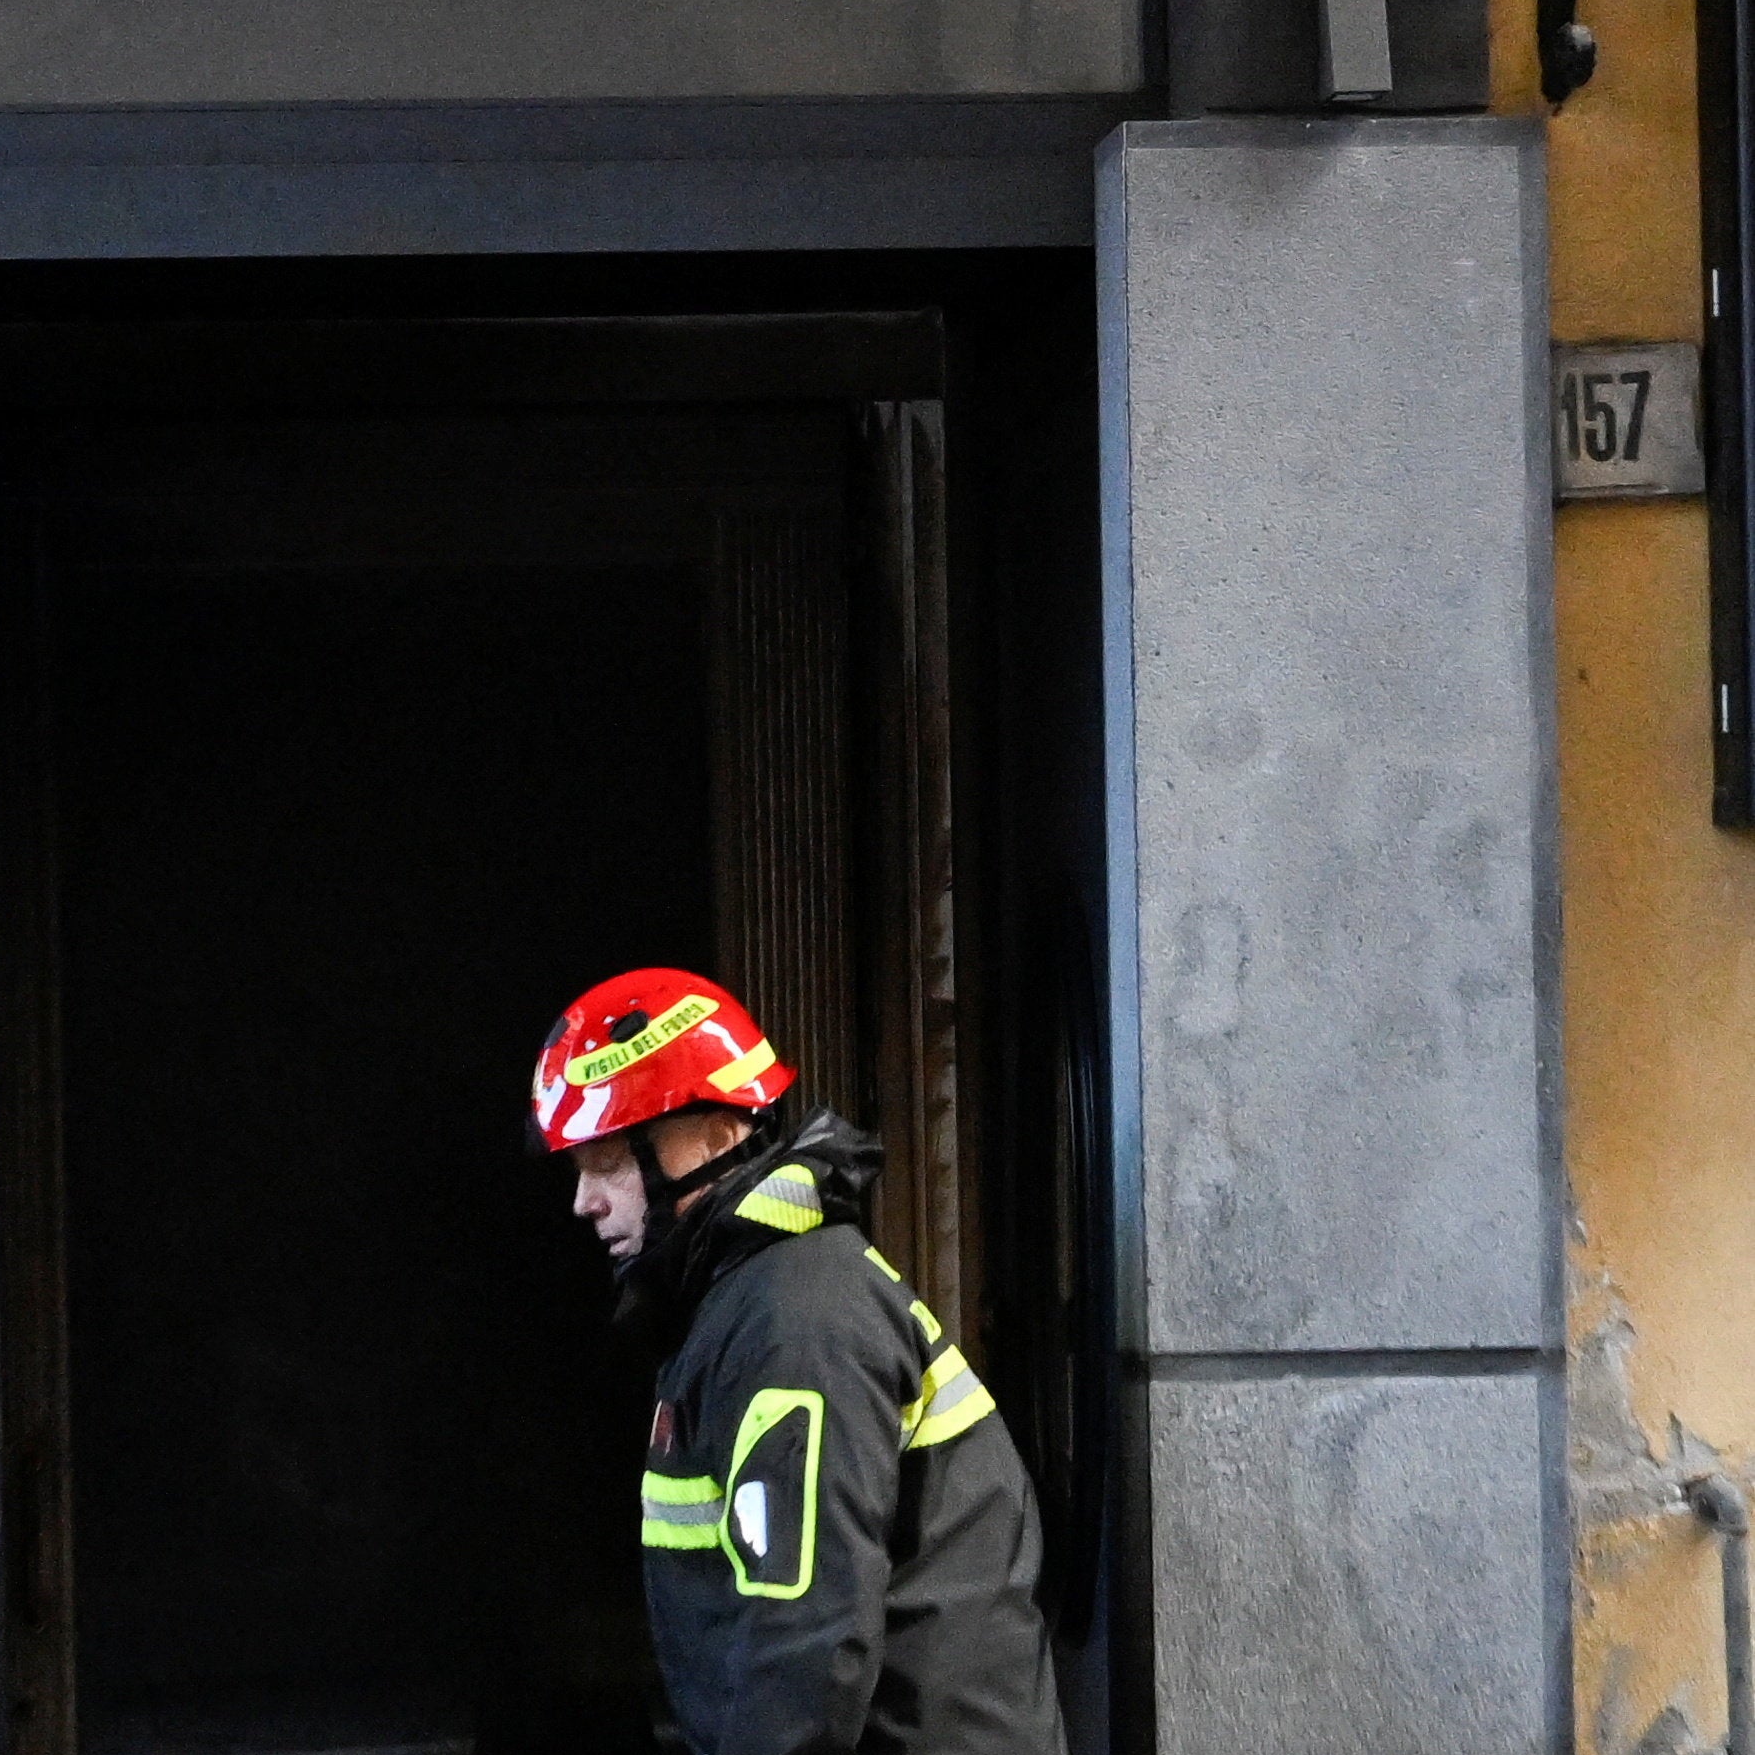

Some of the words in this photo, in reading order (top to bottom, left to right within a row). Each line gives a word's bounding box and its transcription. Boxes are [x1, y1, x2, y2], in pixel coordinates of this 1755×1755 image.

[1560, 371, 1652, 463] 157
[583, 1048, 629, 1080] VIGILI
[631, 1030, 661, 1056] DEL
